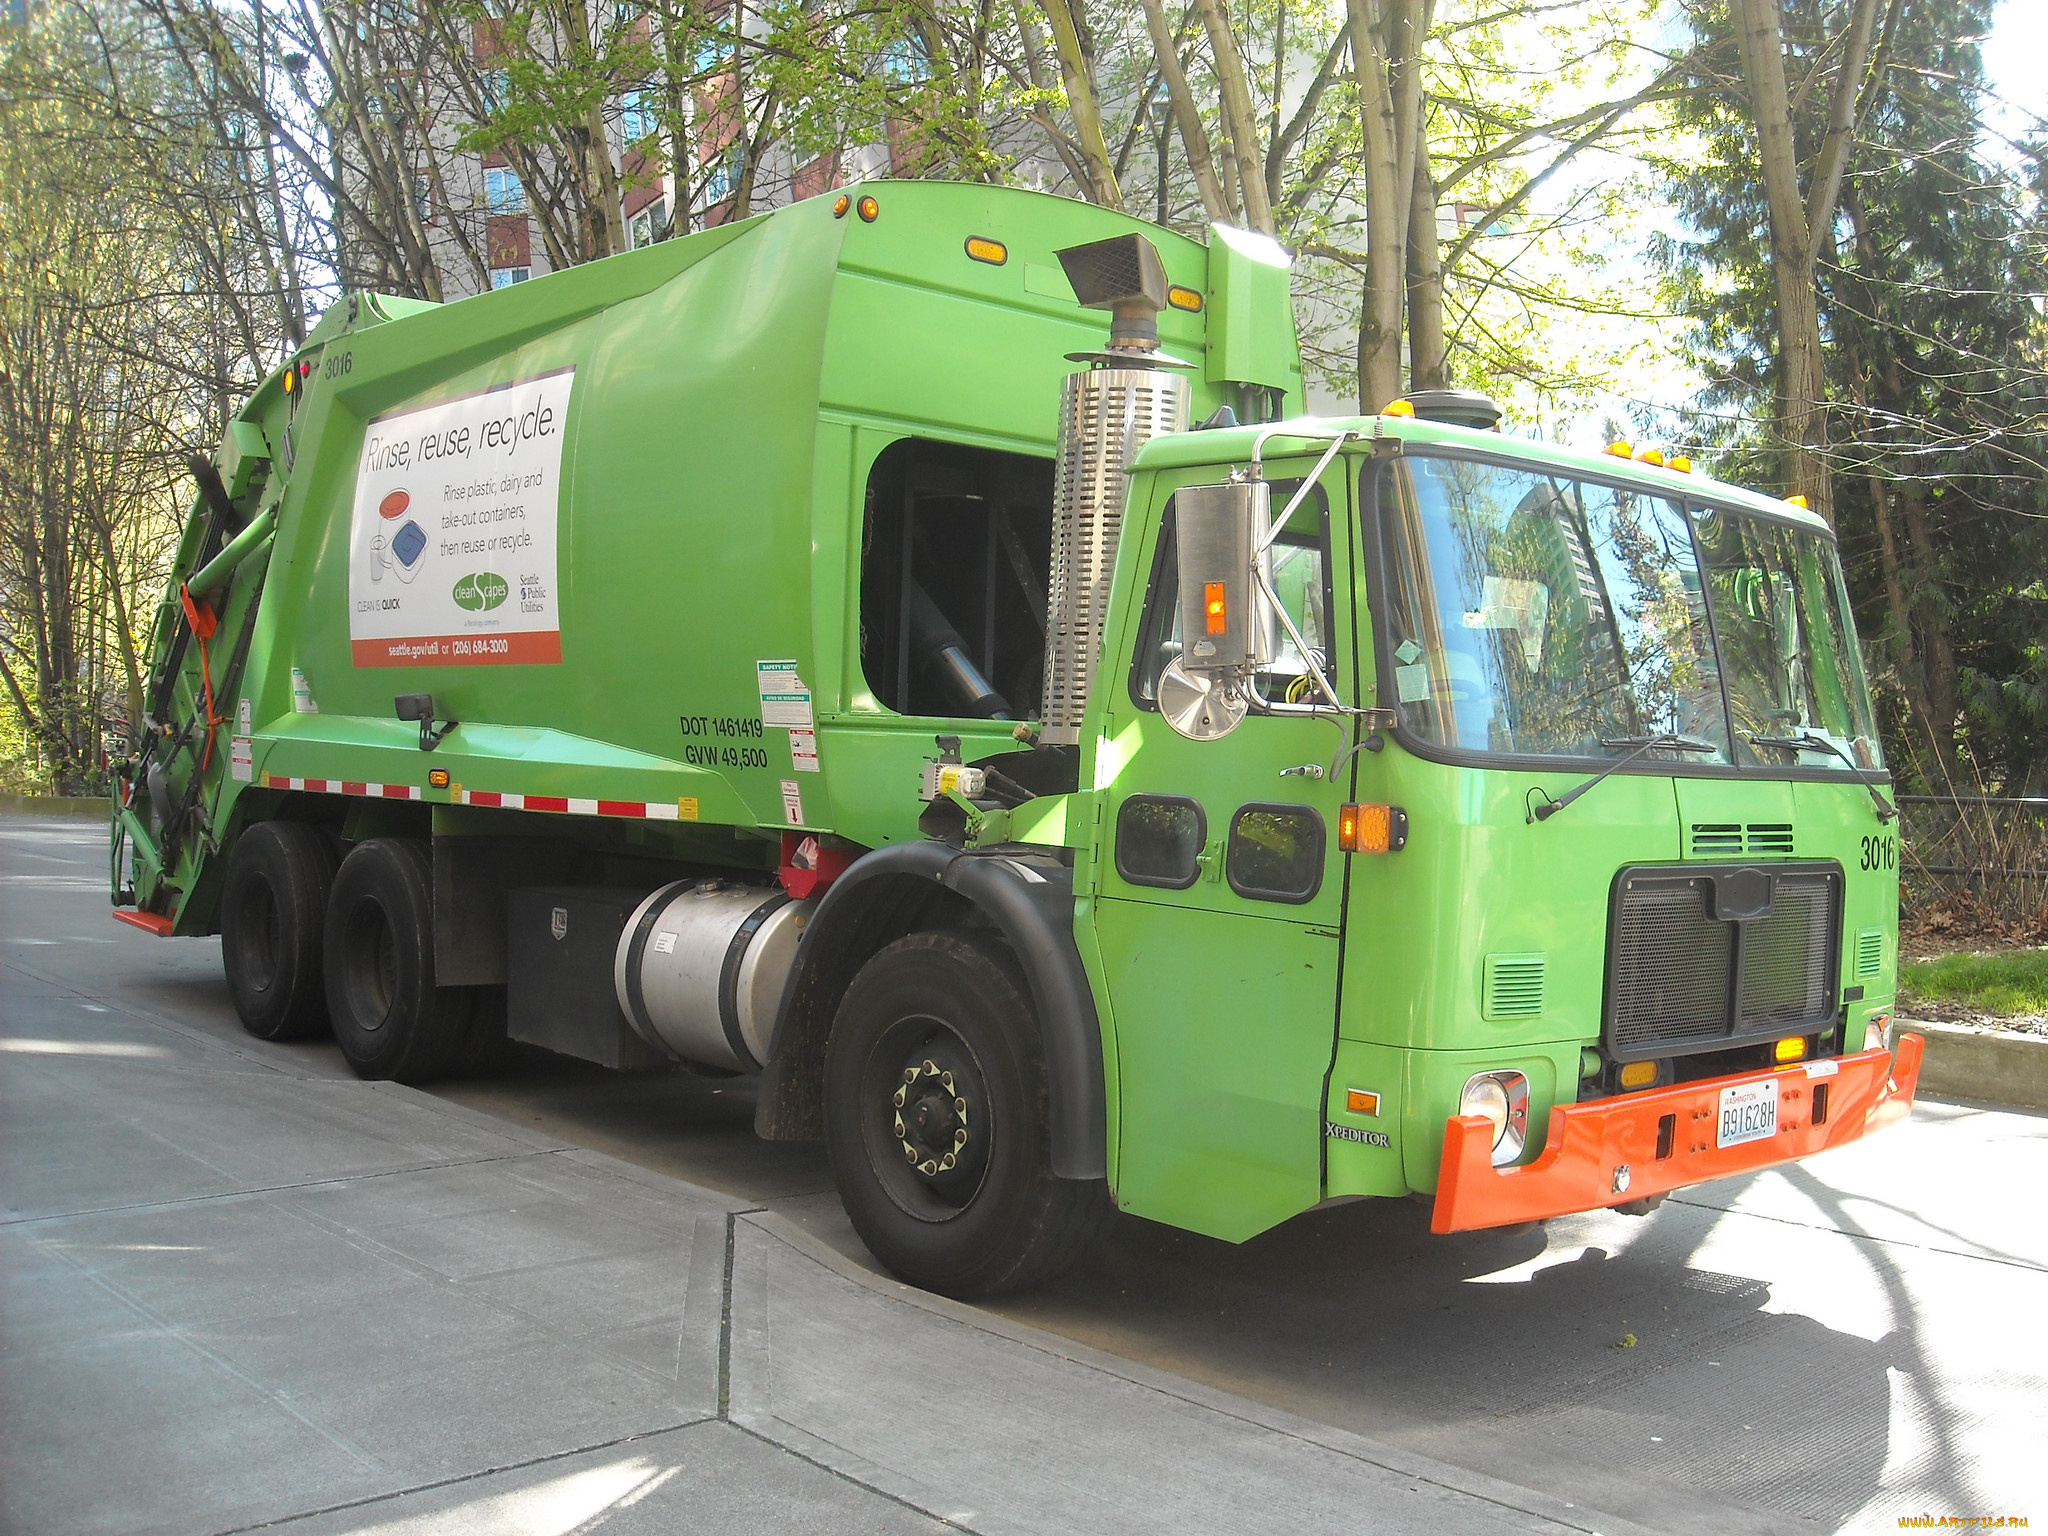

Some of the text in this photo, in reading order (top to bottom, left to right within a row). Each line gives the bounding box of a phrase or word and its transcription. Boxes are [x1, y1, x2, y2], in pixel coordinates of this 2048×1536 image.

[325, 351, 352, 380] 3016
[366, 394, 555, 472] Rinse, reuse, recycle.
[444, 467, 543, 502] Rinse plastic, dairy and
[442, 503, 526, 529] take-out containers,
[441, 528, 532, 557] then reuse or recycle.
[520, 573, 539, 586] Seattle
[382, 598, 401, 610] QUICK
[528, 586, 546, 599] Public
[521, 601, 543, 613] Utilities
[388, 639, 509, 659] seattle.gov/util or (206) 684-3000
[680, 716, 763, 738] DOT 1461419
[685, 745, 768, 770] GVW 49,500
[1860, 835, 1894, 871] 3016
[1725, 1093, 1757, 1105] WASHINGTON
[1723, 1100, 1775, 1138] B91628H
[1325, 1120, 1391, 1148] XPEDITOR
